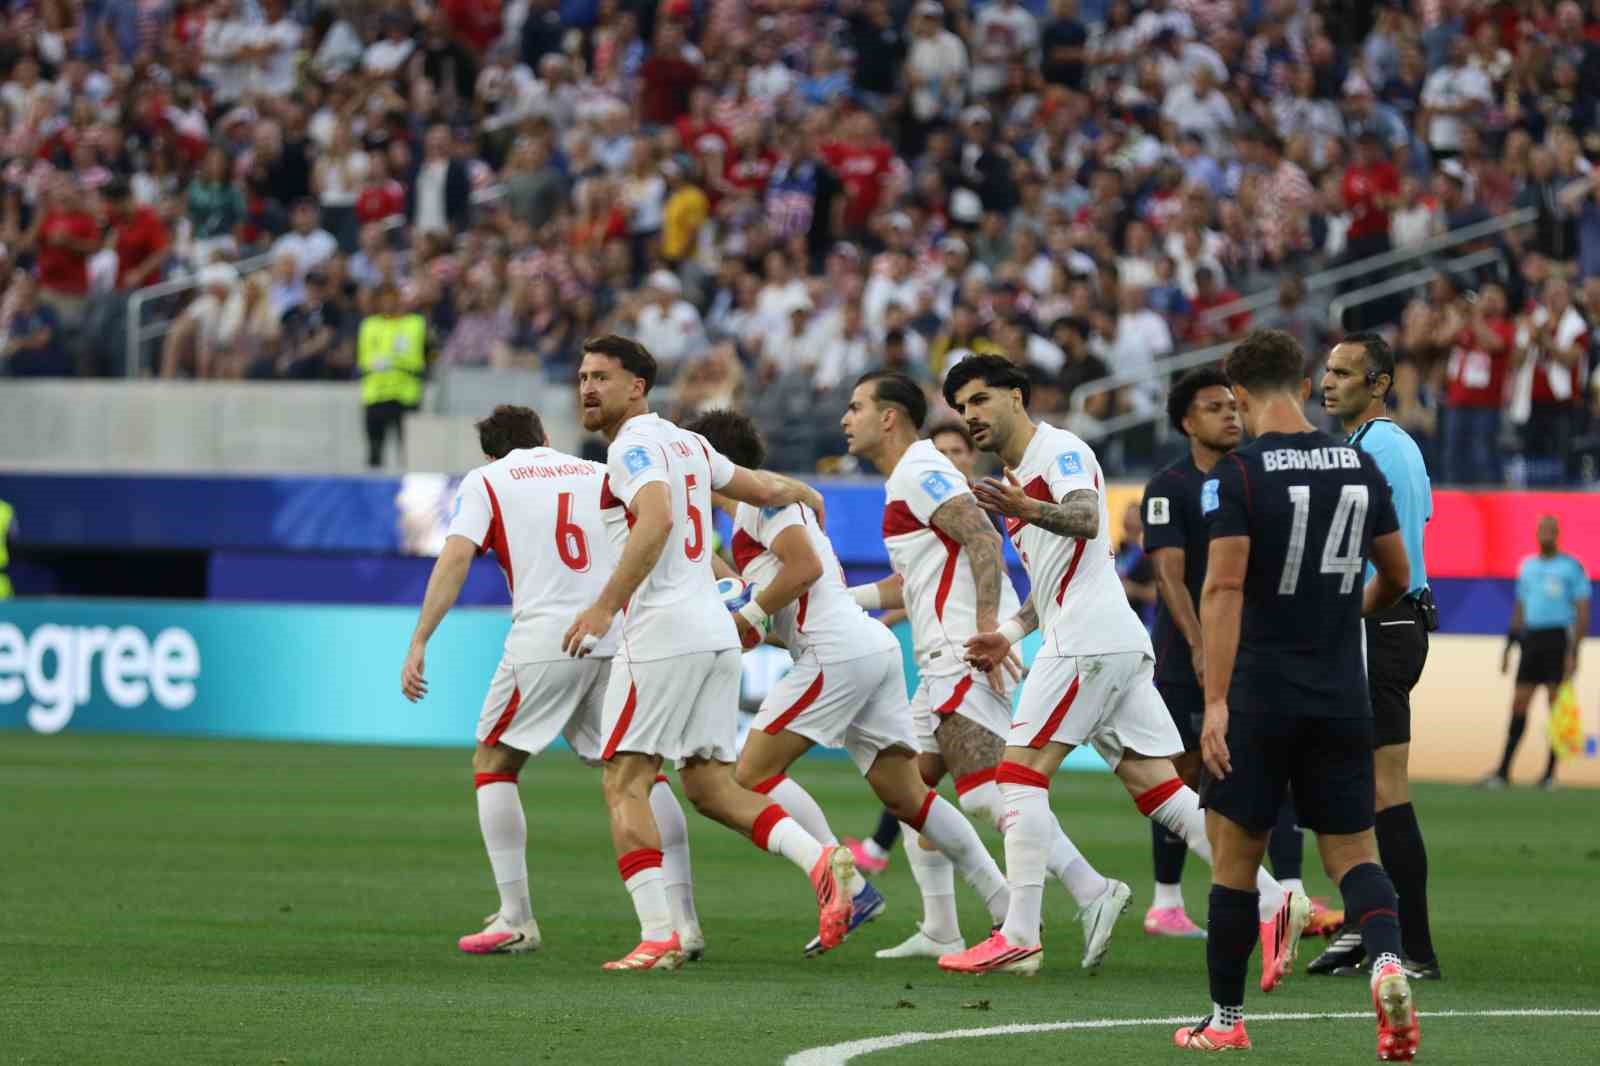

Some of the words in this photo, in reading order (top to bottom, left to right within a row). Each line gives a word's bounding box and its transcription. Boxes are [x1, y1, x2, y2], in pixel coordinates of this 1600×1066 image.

[509, 465, 556, 480] ORKUN
[1262, 446, 1361, 472] BERHALTER
[555, 491, 592, 573] 6
[683, 474, 704, 562] 5
[1277, 485, 1369, 595] 14
